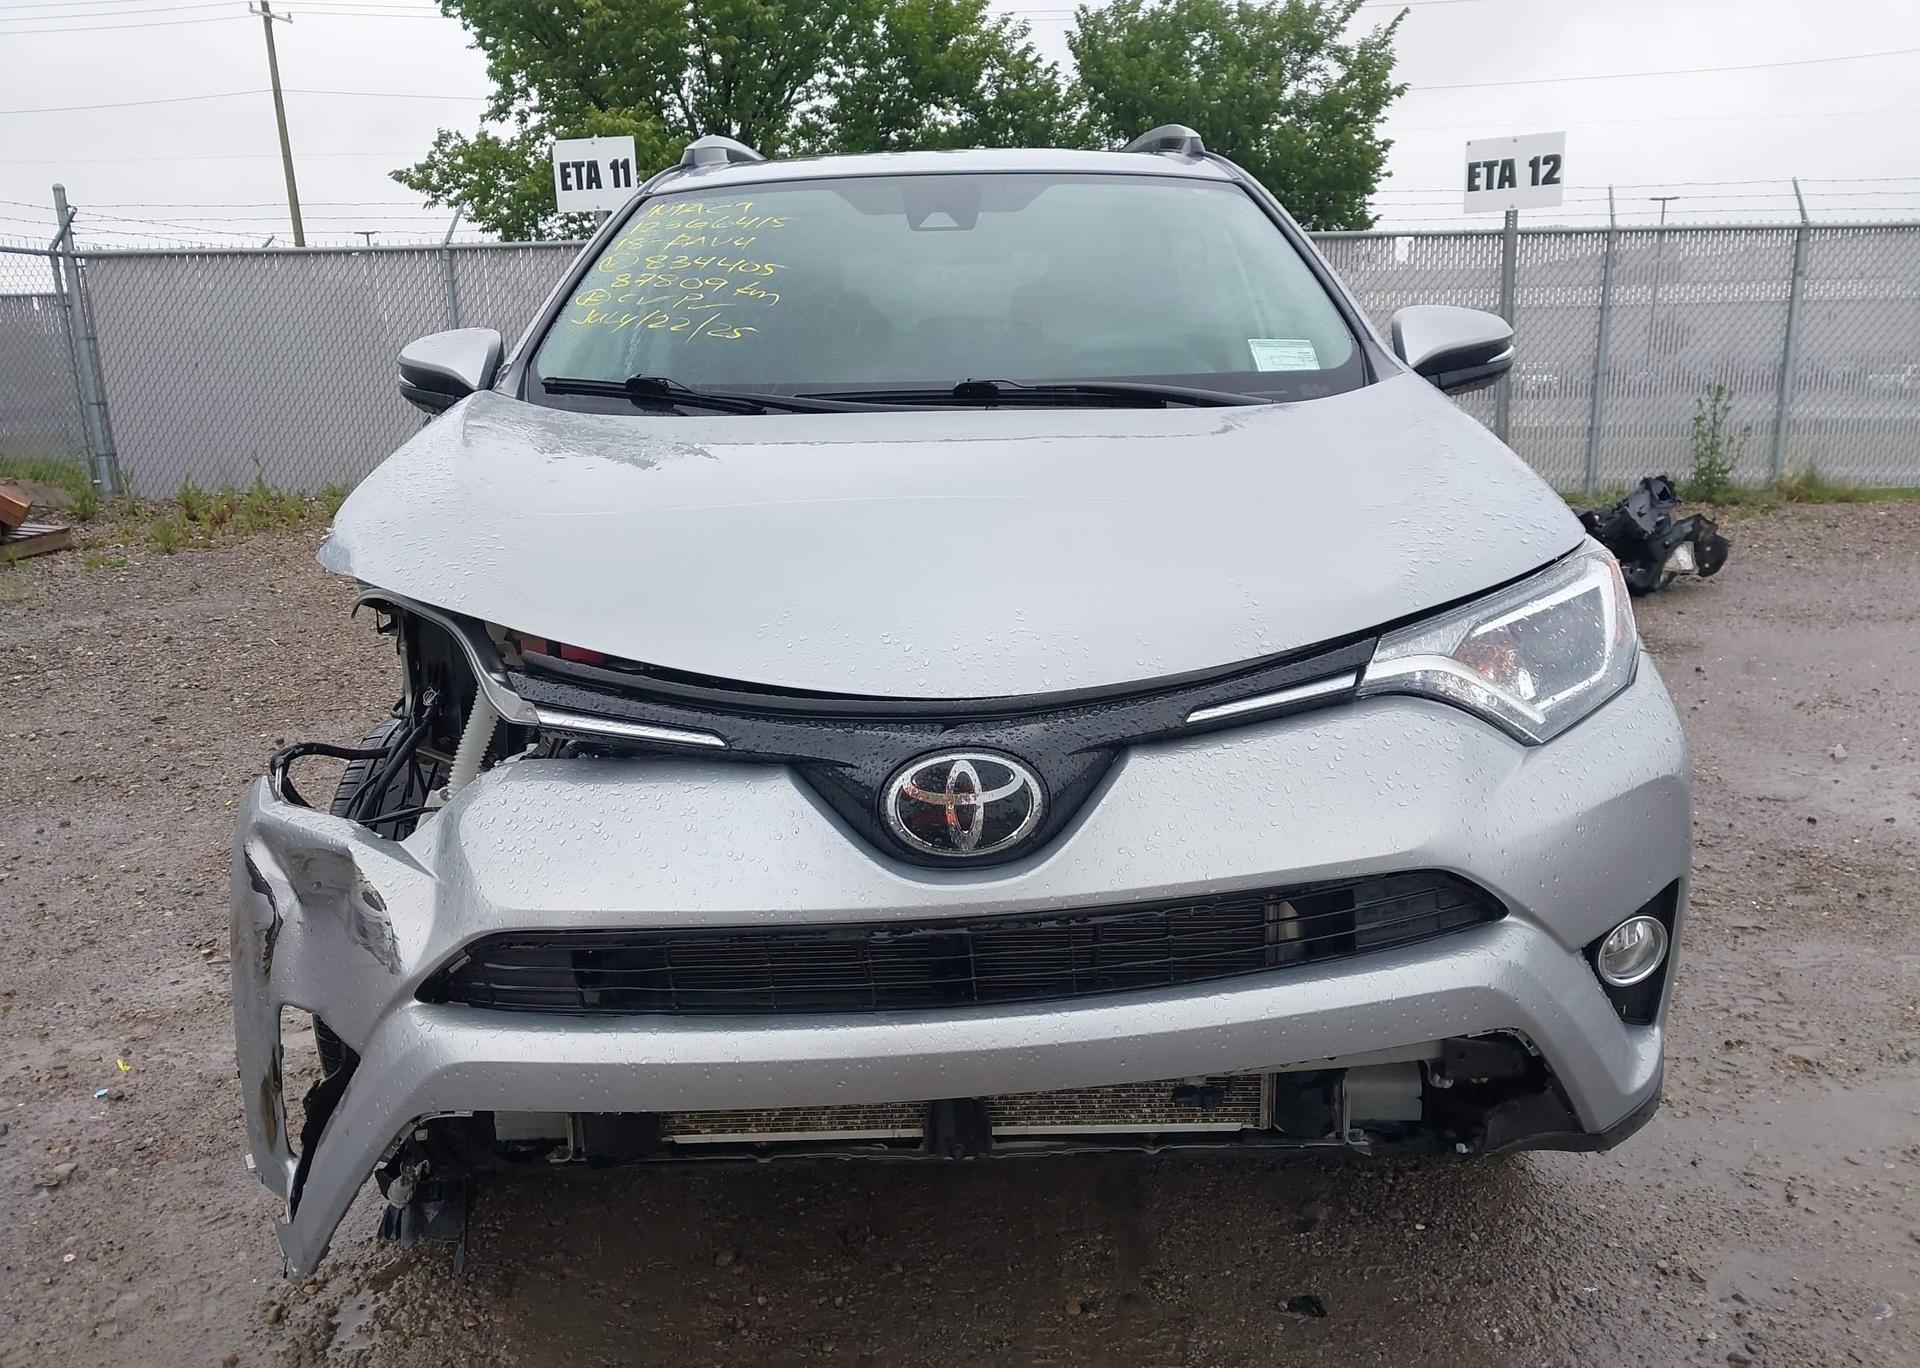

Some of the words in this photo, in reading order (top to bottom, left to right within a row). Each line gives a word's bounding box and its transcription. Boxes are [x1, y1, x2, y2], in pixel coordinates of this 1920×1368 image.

[559, 160, 602, 191] ETA
[609, 158, 632, 188] 11
[1467, 158, 1517, 192] ETA
[1528, 154, 1562, 186] 12
[645, 255, 788, 276] 834405
